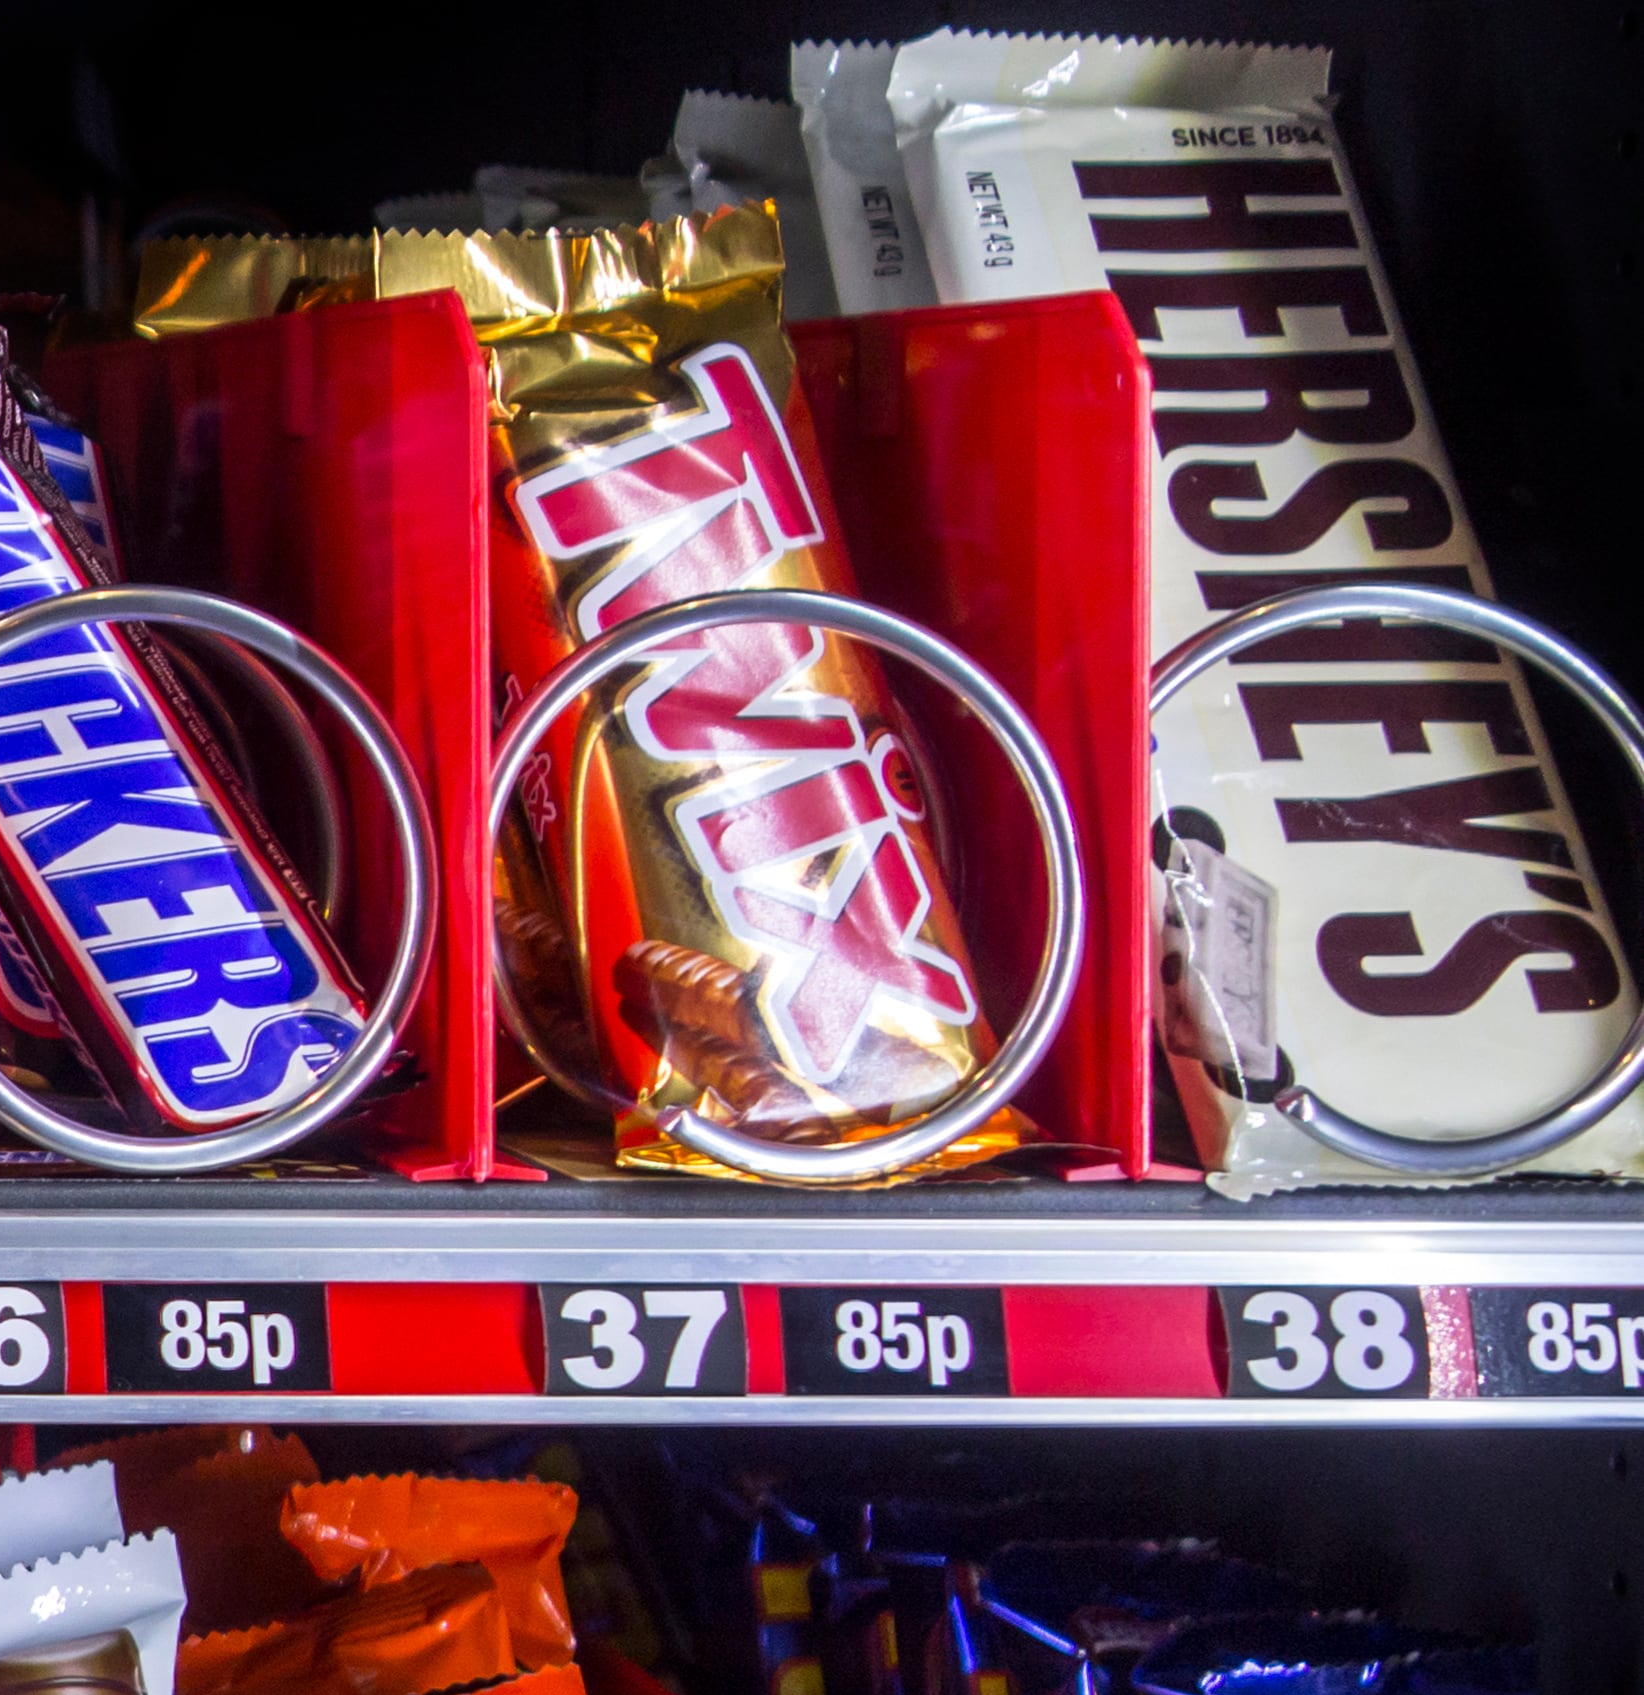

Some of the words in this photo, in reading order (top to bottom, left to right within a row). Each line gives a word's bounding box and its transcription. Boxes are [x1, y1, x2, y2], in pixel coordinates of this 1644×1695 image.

[1171, 125, 1256, 149] SINCE
[964, 167, 1000, 204] NET
[1072, 159, 1623, 1018] HERSHEY'S
[520, 343, 976, 1083] TWIX
[161, 1300, 294, 1384] 85p
[561, 1290, 726, 1389] 37
[836, 1301, 969, 1386] 85p
[1243, 1291, 1411, 1391] 38
